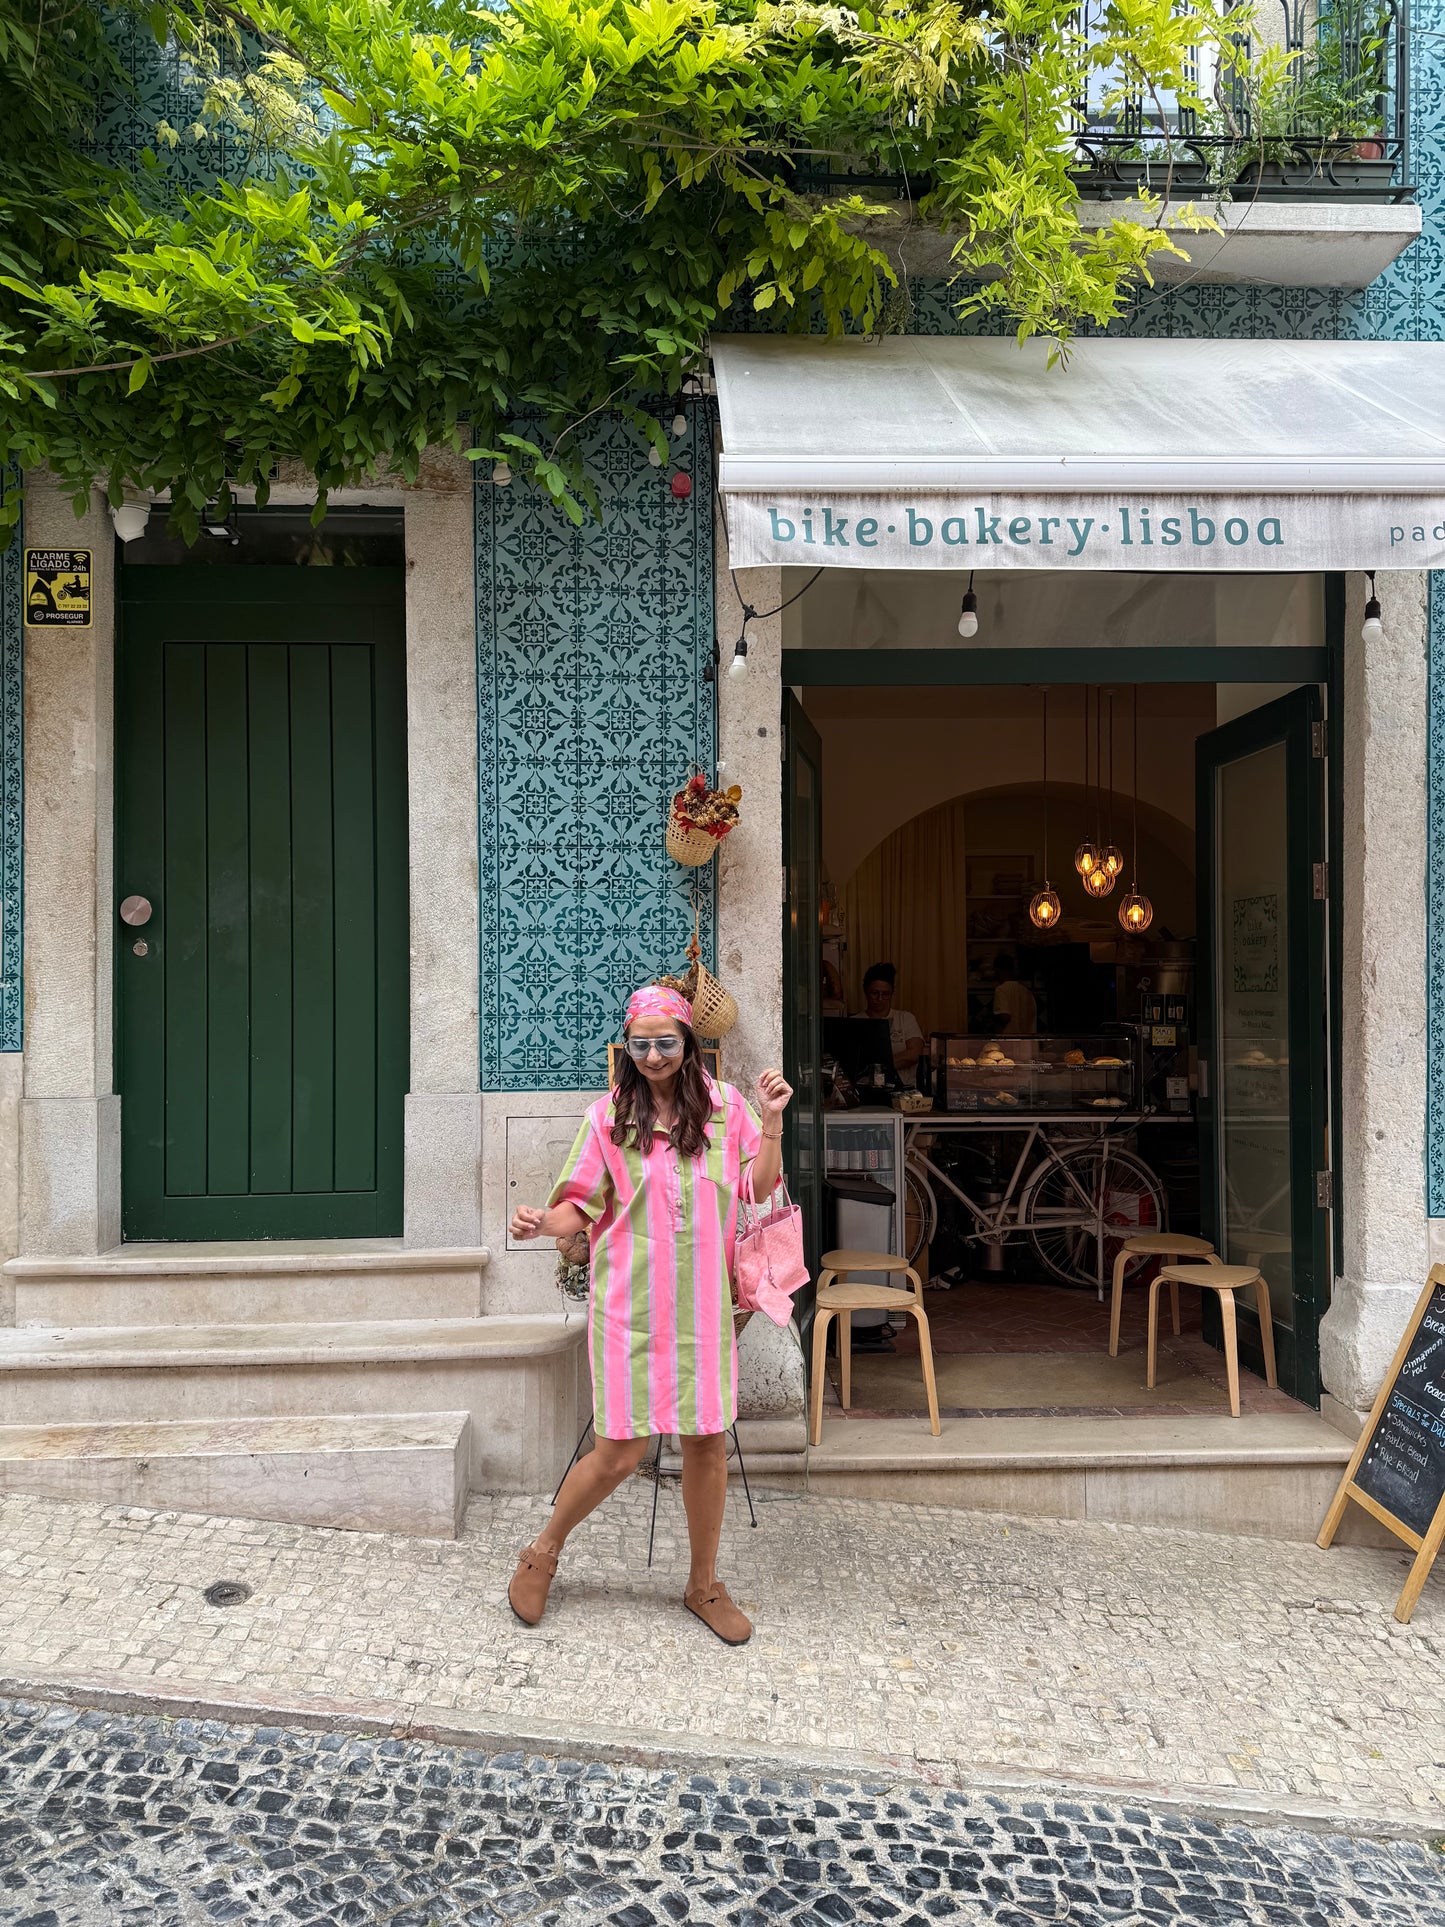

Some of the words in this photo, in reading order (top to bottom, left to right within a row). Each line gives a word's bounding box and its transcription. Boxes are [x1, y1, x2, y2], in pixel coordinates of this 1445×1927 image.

[1390, 521, 1445, 547] pad
[30, 552, 70, 560] ALARME
[30, 560, 71, 568] LIGADO
[1402, 1338, 1443, 1375] Cinnamon
[1391, 1413, 1427, 1447] Sandwiches
[1407, 1445, 1430, 1468] Bread
